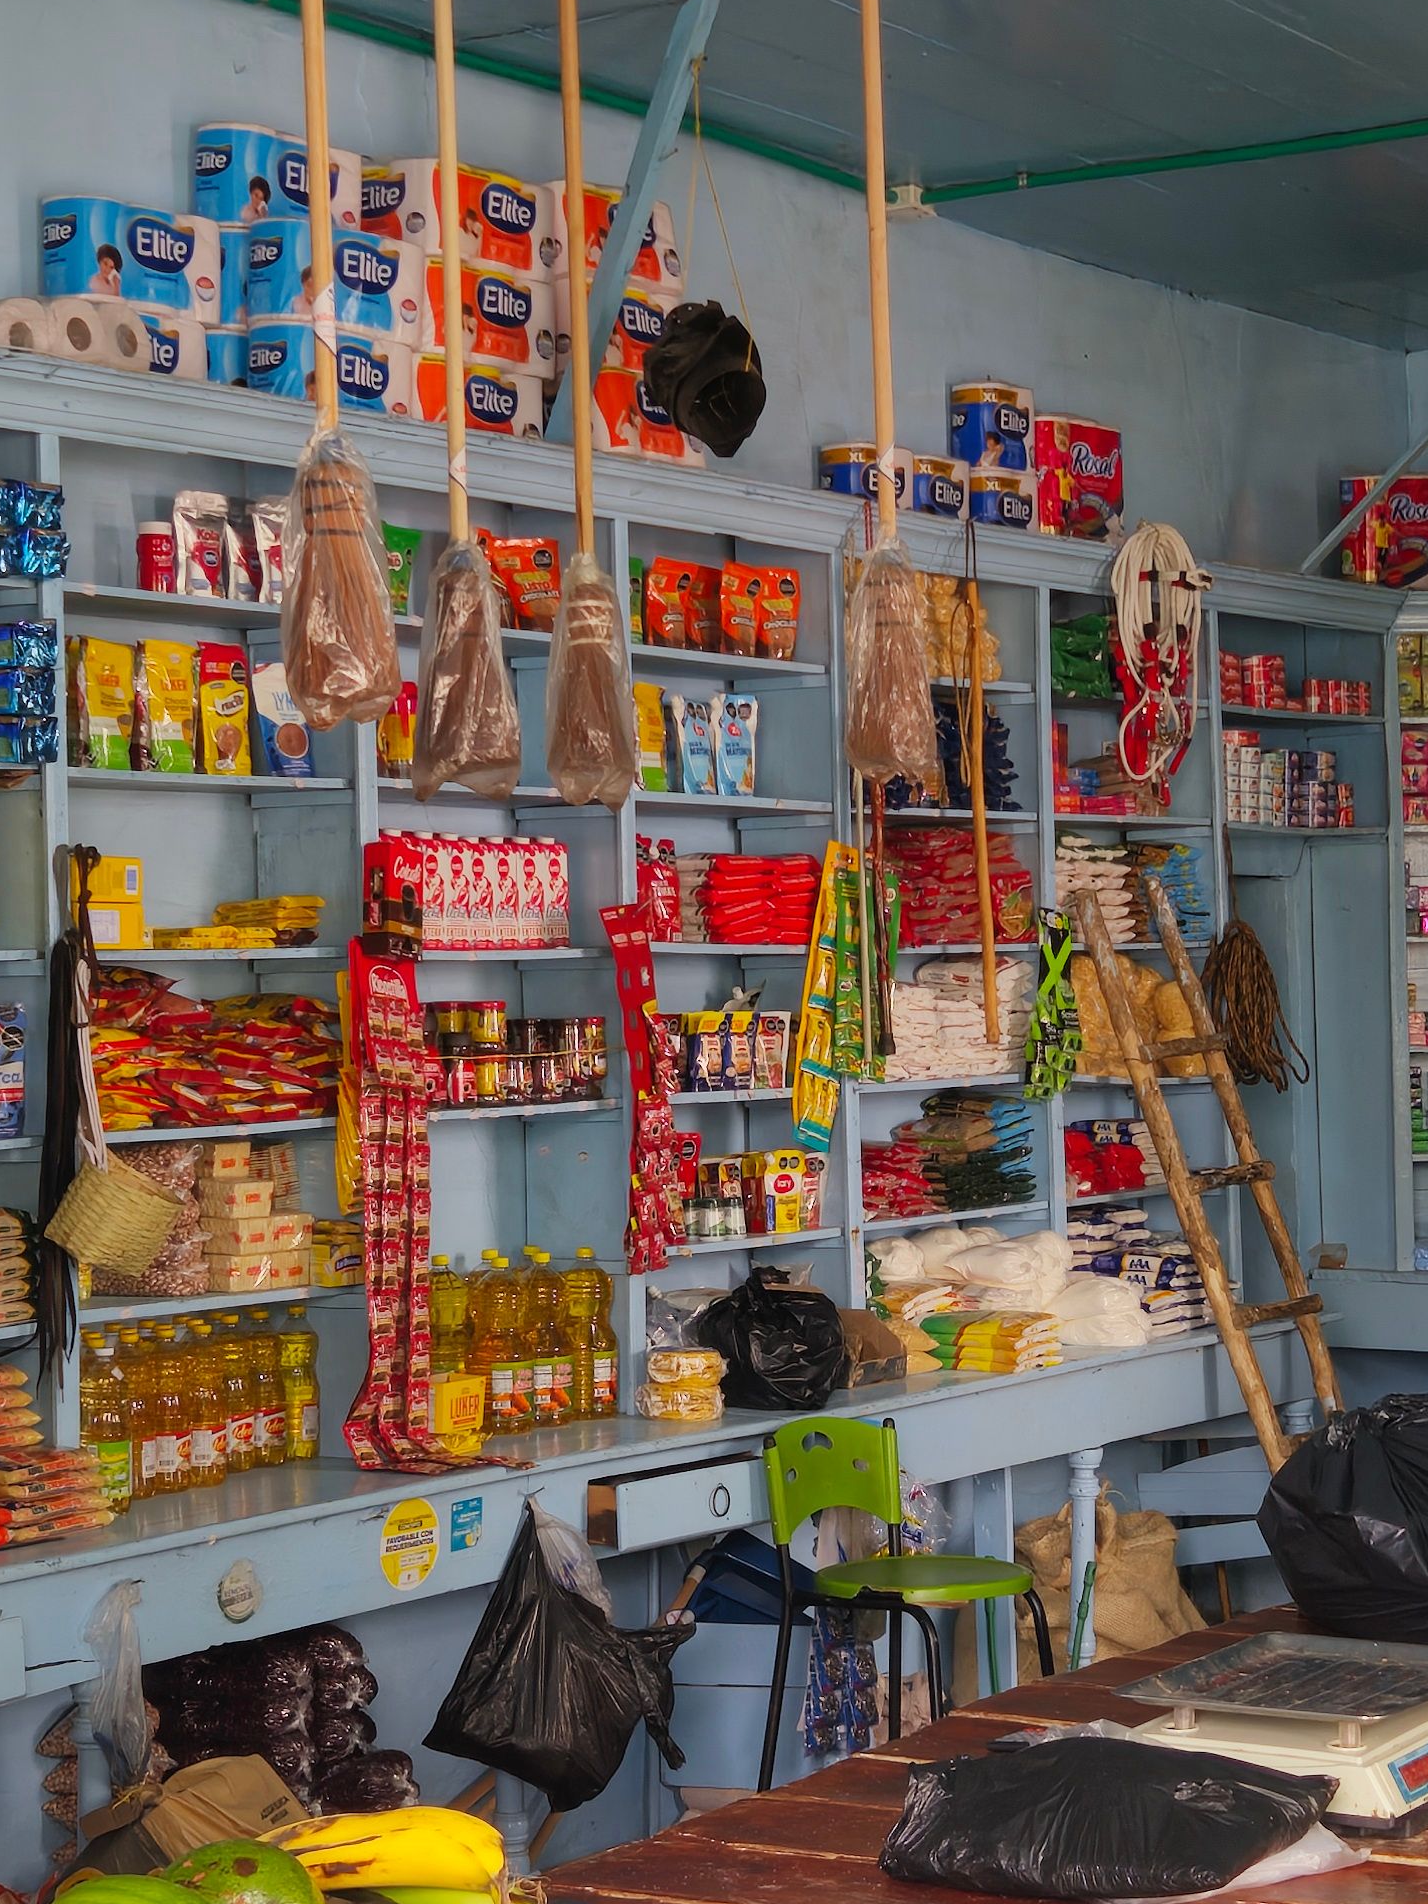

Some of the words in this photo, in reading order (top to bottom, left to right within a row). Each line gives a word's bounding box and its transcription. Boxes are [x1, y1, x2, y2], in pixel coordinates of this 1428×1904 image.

[488, 191, 532, 227] Elite
[136, 226, 189, 264] Elite
[343, 250, 393, 286] Elite
[482, 285, 528, 320] Elite
[623, 304, 662, 337] Elite
[341, 354, 384, 390] Elite
[470, 382, 515, 416] Elite
[983, 391, 999, 403] XL
[1000, 409, 1028, 434] Elite
[849, 451, 867, 463] XL
[918, 463, 934, 474] XL
[1071, 442, 1119, 480] Rosal
[934, 483, 963, 508] Elite
[986, 480, 1002, 492] XL
[1002, 499, 1031, 523] Elite
[196, 528, 220, 542] Kola
[1129, 1258, 1150, 1271] AAA
[1125, 1274, 1146, 1286] AAA
[450, 1395, 480, 1419] LUKER
